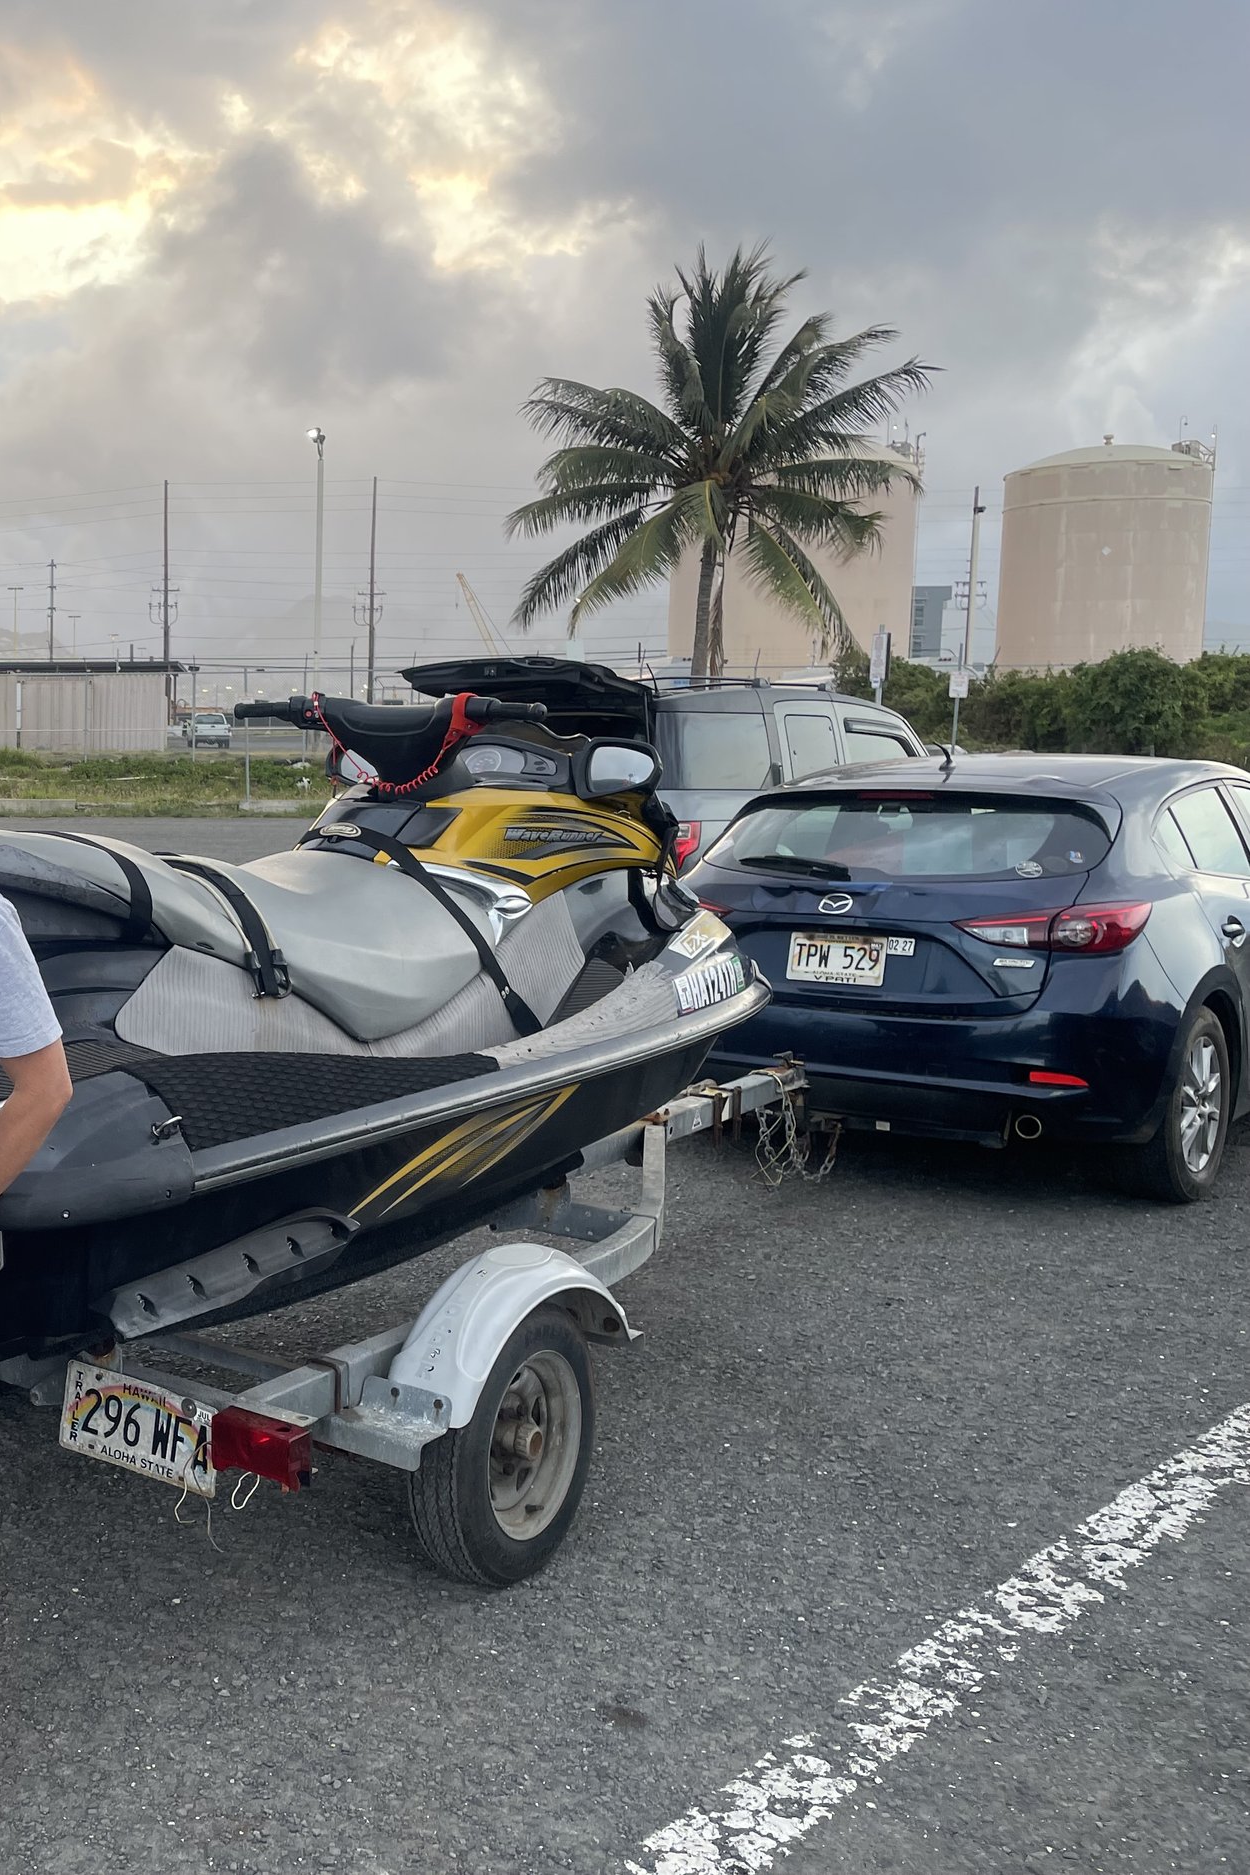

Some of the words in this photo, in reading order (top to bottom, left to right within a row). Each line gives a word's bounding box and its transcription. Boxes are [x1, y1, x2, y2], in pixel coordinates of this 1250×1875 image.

[796, 943, 831, 968] TPW
[842, 946, 880, 971] 529
[889, 940, 898, 950] 02
[903, 941, 913, 951] 27
[69, 1370, 84, 1442] TRAILER
[123, 1383, 166, 1407] HAWAII
[197, 1411, 210, 1421] JUL
[82, 1389, 141, 1447] 296
[151, 1410, 208, 1475] WFA
[100, 1445, 137, 1467] ALOHA
[140, 1458, 174, 1478] STATE
